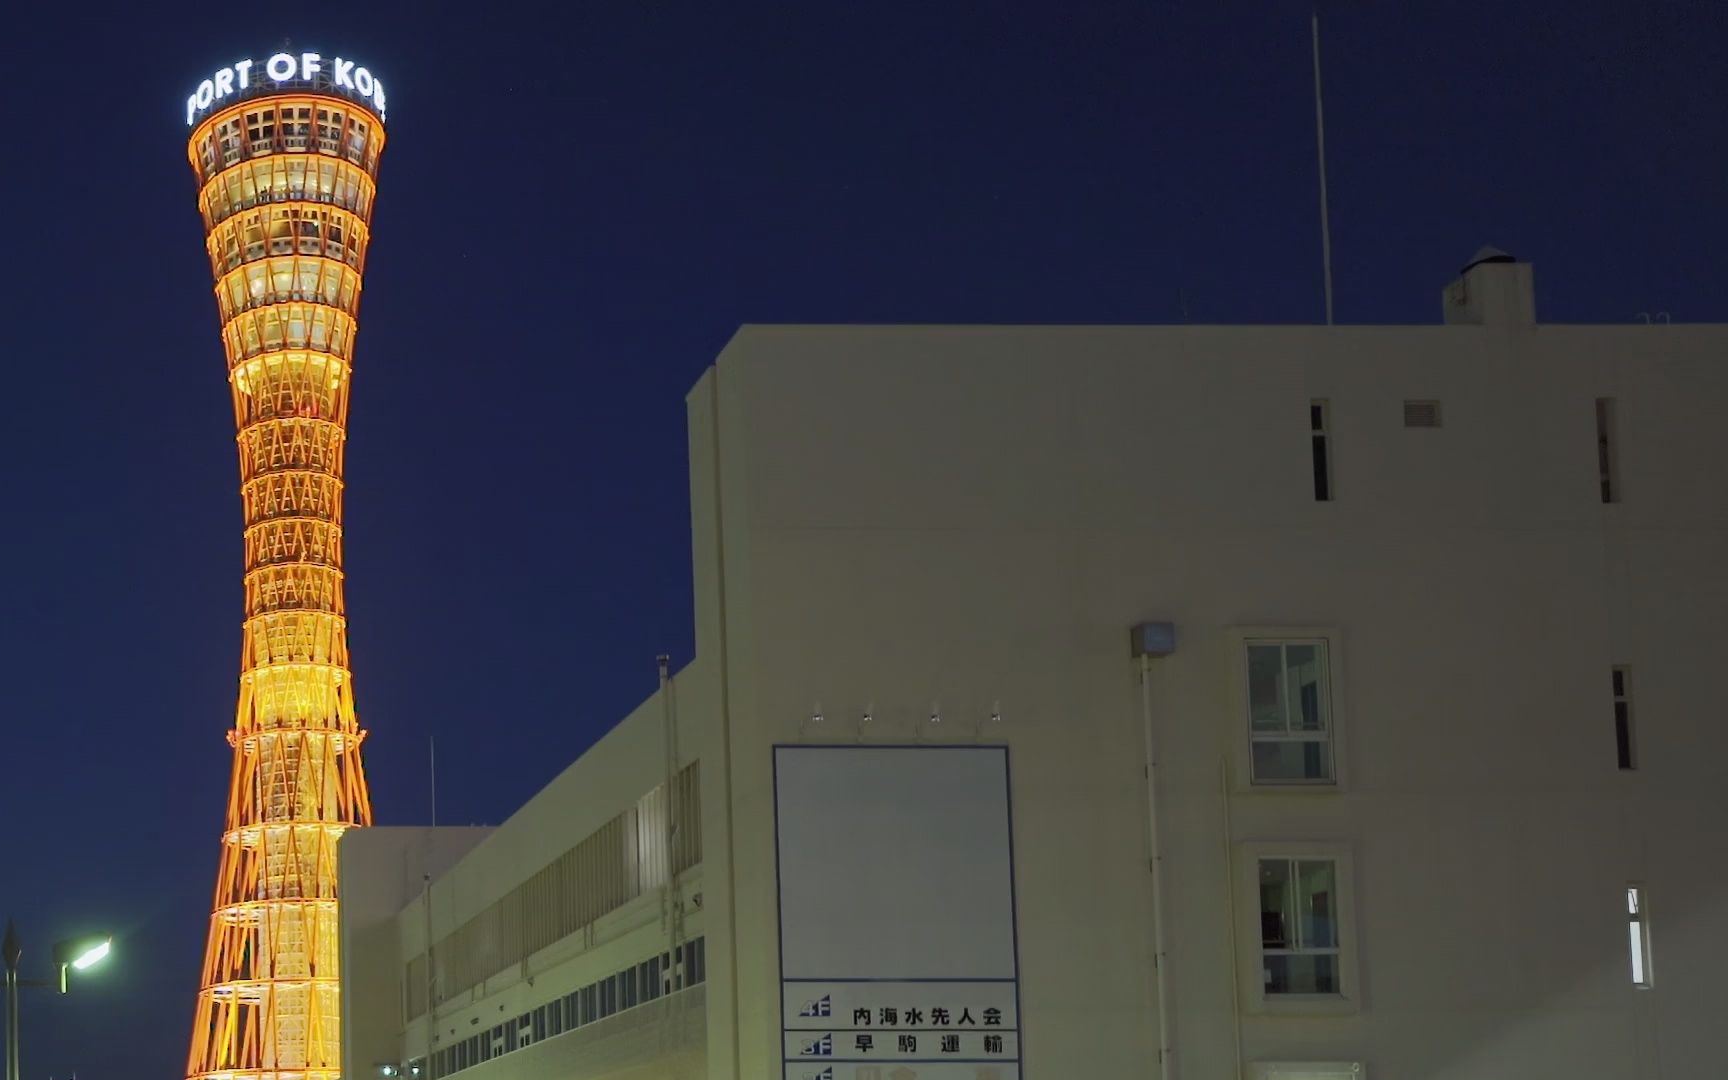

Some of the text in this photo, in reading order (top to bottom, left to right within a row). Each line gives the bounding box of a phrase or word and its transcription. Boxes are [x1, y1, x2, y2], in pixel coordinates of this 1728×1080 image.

[186, 52, 386, 126] PORT OF KOB
[800, 999, 1002, 1026] 4F 内海水先人会
[801, 1035, 1003, 1055] 3F 早駒運輸
